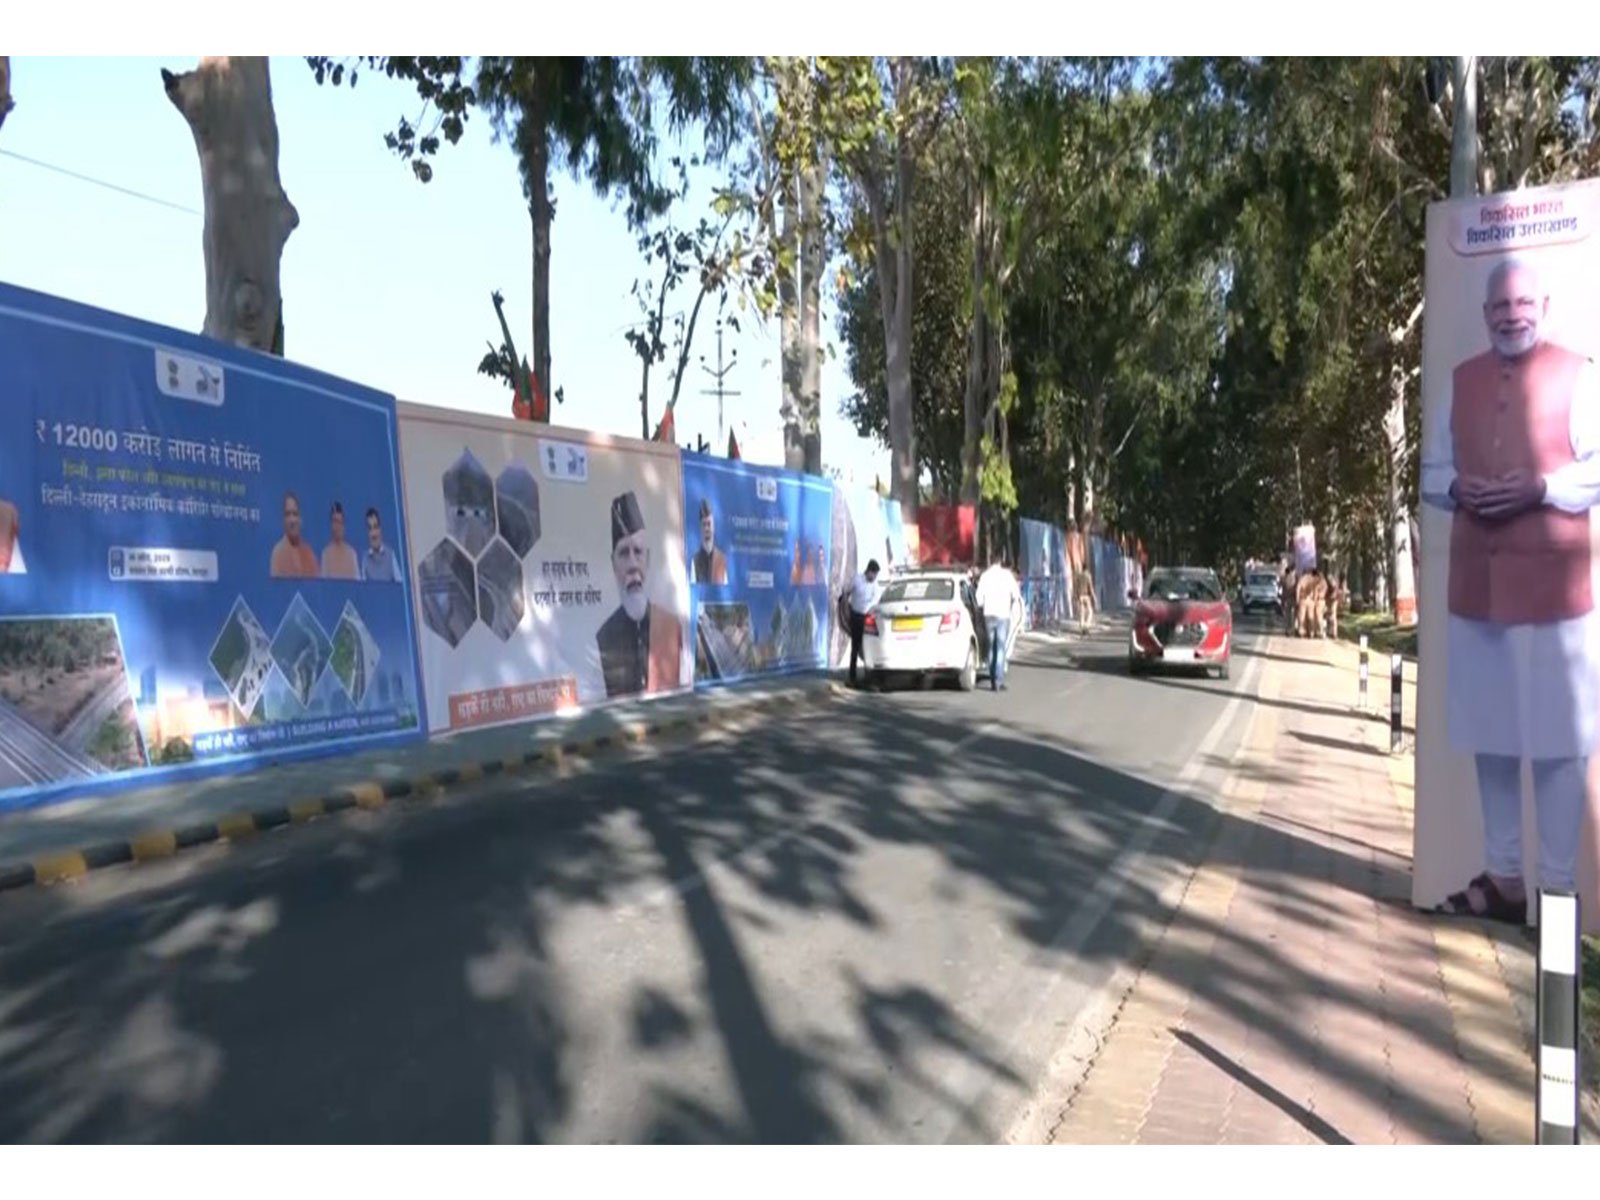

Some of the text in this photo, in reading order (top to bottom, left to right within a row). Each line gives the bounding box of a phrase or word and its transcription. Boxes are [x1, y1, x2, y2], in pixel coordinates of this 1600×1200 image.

[1480, 200, 1564, 224] विकसित भारत
[1467, 226, 1515, 245] विकसित
[52, 423, 118, 451] 12000
[168, 438, 206, 463] लागत
